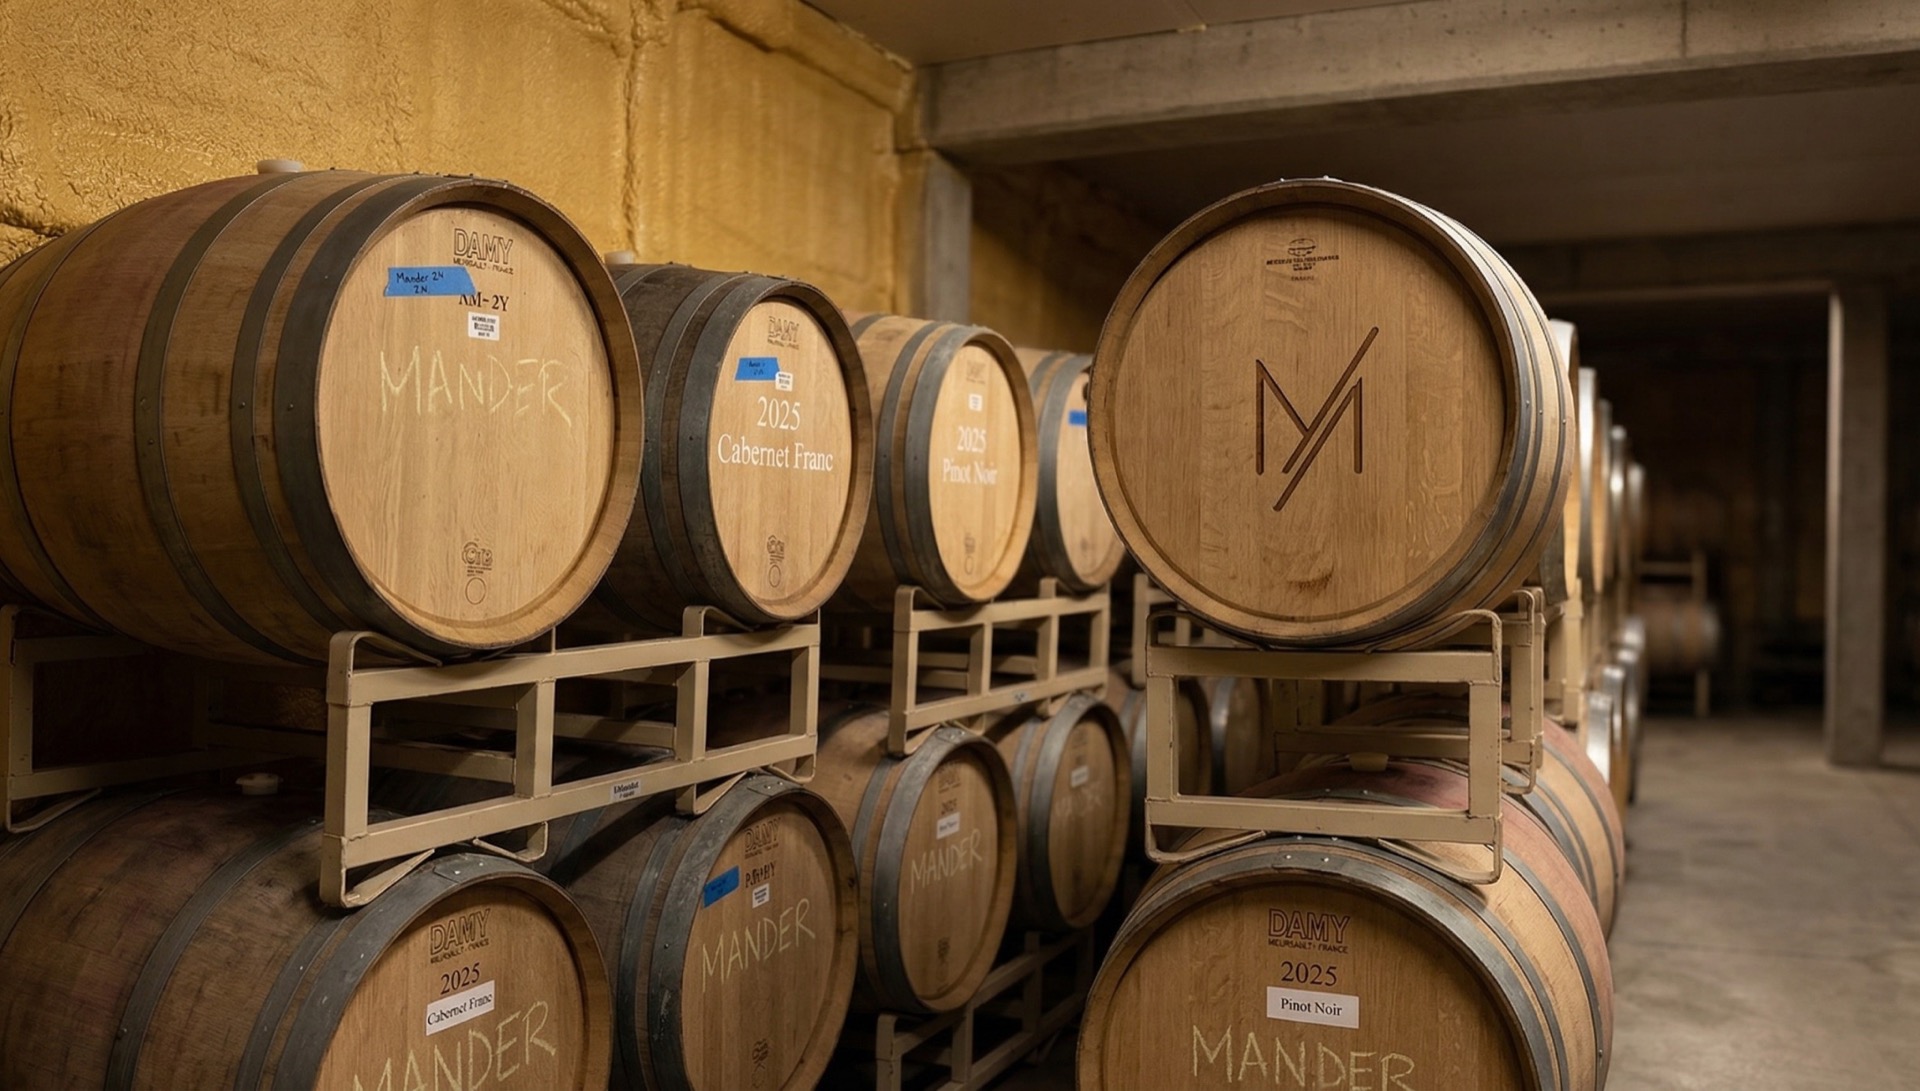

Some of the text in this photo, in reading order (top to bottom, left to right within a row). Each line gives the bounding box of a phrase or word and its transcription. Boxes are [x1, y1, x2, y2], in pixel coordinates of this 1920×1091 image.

[453, 228, 514, 265] DAMY
[396, 272, 429, 284] Mander
[379, 345, 572, 427] MANDER
[757, 396, 801, 431] 2025
[717, 434, 834, 472] Cabernet Franc
[957, 426, 987, 454] 2025
[943, 458, 998, 485] Pinot Noir
[910, 828, 983, 894] MANDER
[430, 908, 491, 955] DAMY
[1268, 908, 1350, 943] DAMY
[701, 898, 816, 993] MANDER
[440, 962, 481, 995] 2025
[1281, 961, 1338, 986] 2025
[427, 993, 493, 1025] Cabernet Franc
[1281, 998, 1342, 1016] Pinot Noir
[1193, 1024, 1416, 1091] MANDER
